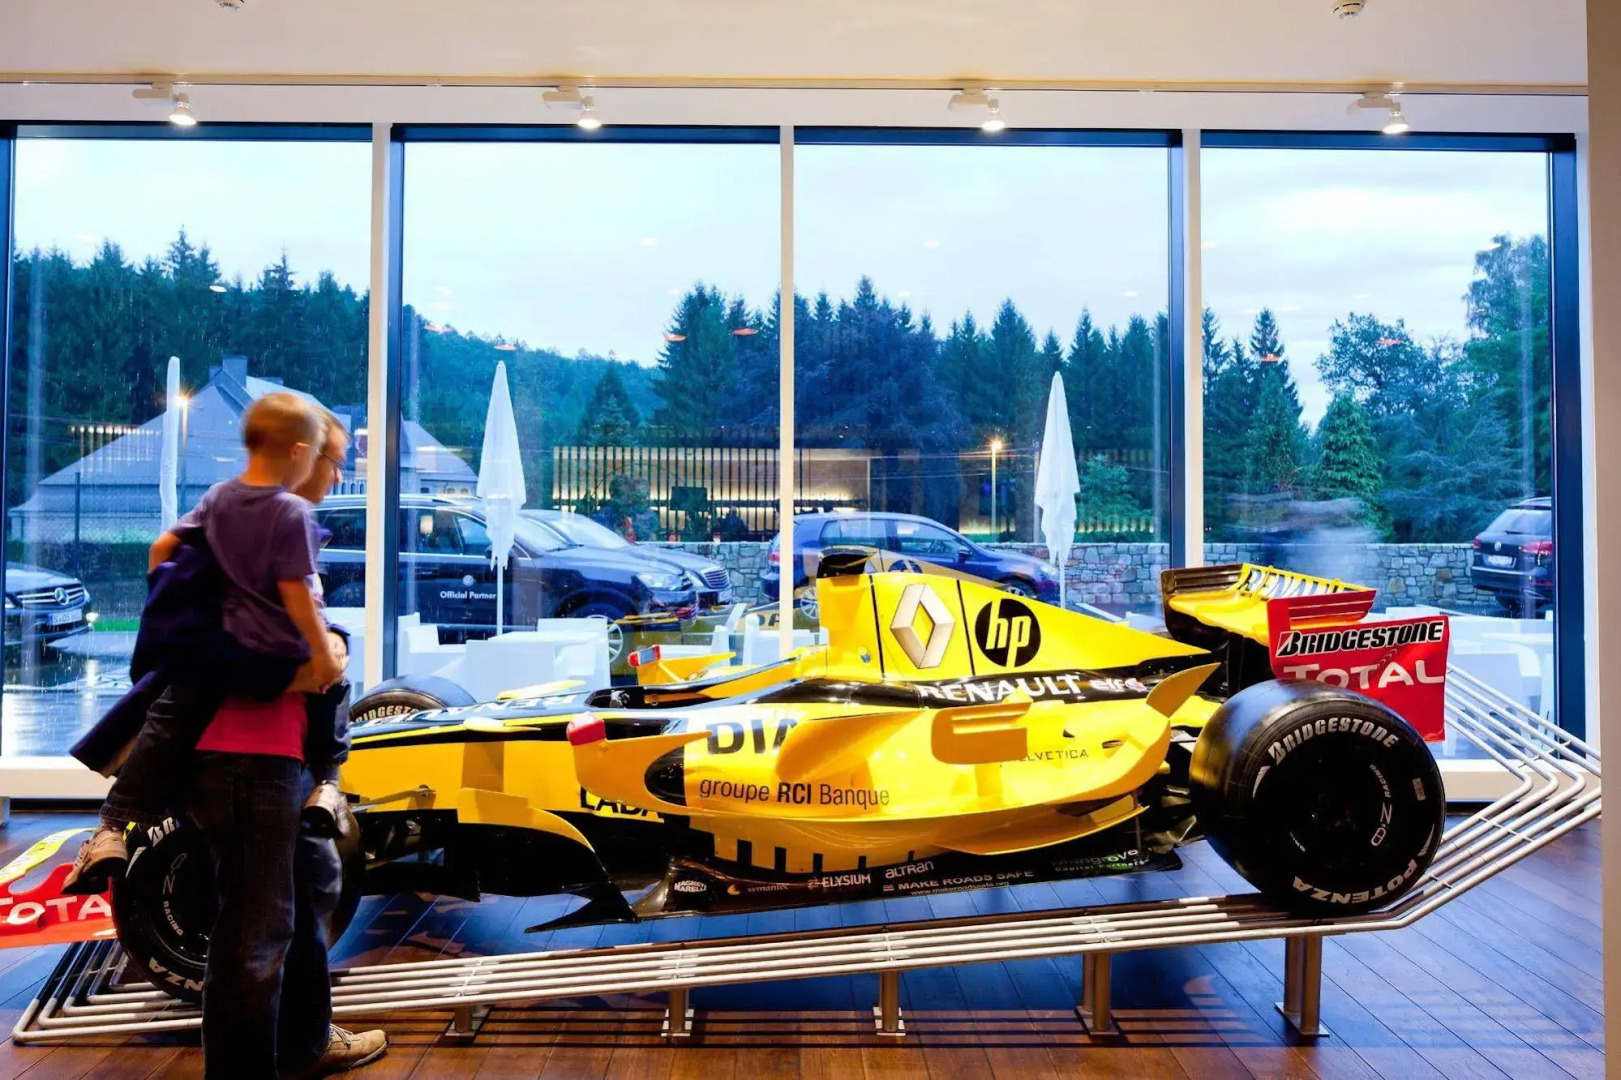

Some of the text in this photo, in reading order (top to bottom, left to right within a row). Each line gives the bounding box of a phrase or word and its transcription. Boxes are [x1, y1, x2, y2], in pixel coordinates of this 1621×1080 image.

[440, 591, 497, 600] Official Partner
[986, 599, 1032, 668] hp
[1276, 620, 1445, 657] BRIDGESTONE
[917, 674, 1081, 703] RENAULT
[1283, 659, 1445, 690] TOTAL
[1268, 717, 1399, 766] BRIDGESTONE
[700, 778, 890, 807] groupe RCI Banque
[822, 874, 871, 888] ELYSIUM
[898, 870, 1035, 891] MAKE ROADS SAFE
[1292, 858, 1418, 905] POTENZA
[0, 894, 112, 925] OTA
[163, 900, 184, 936] RACING
